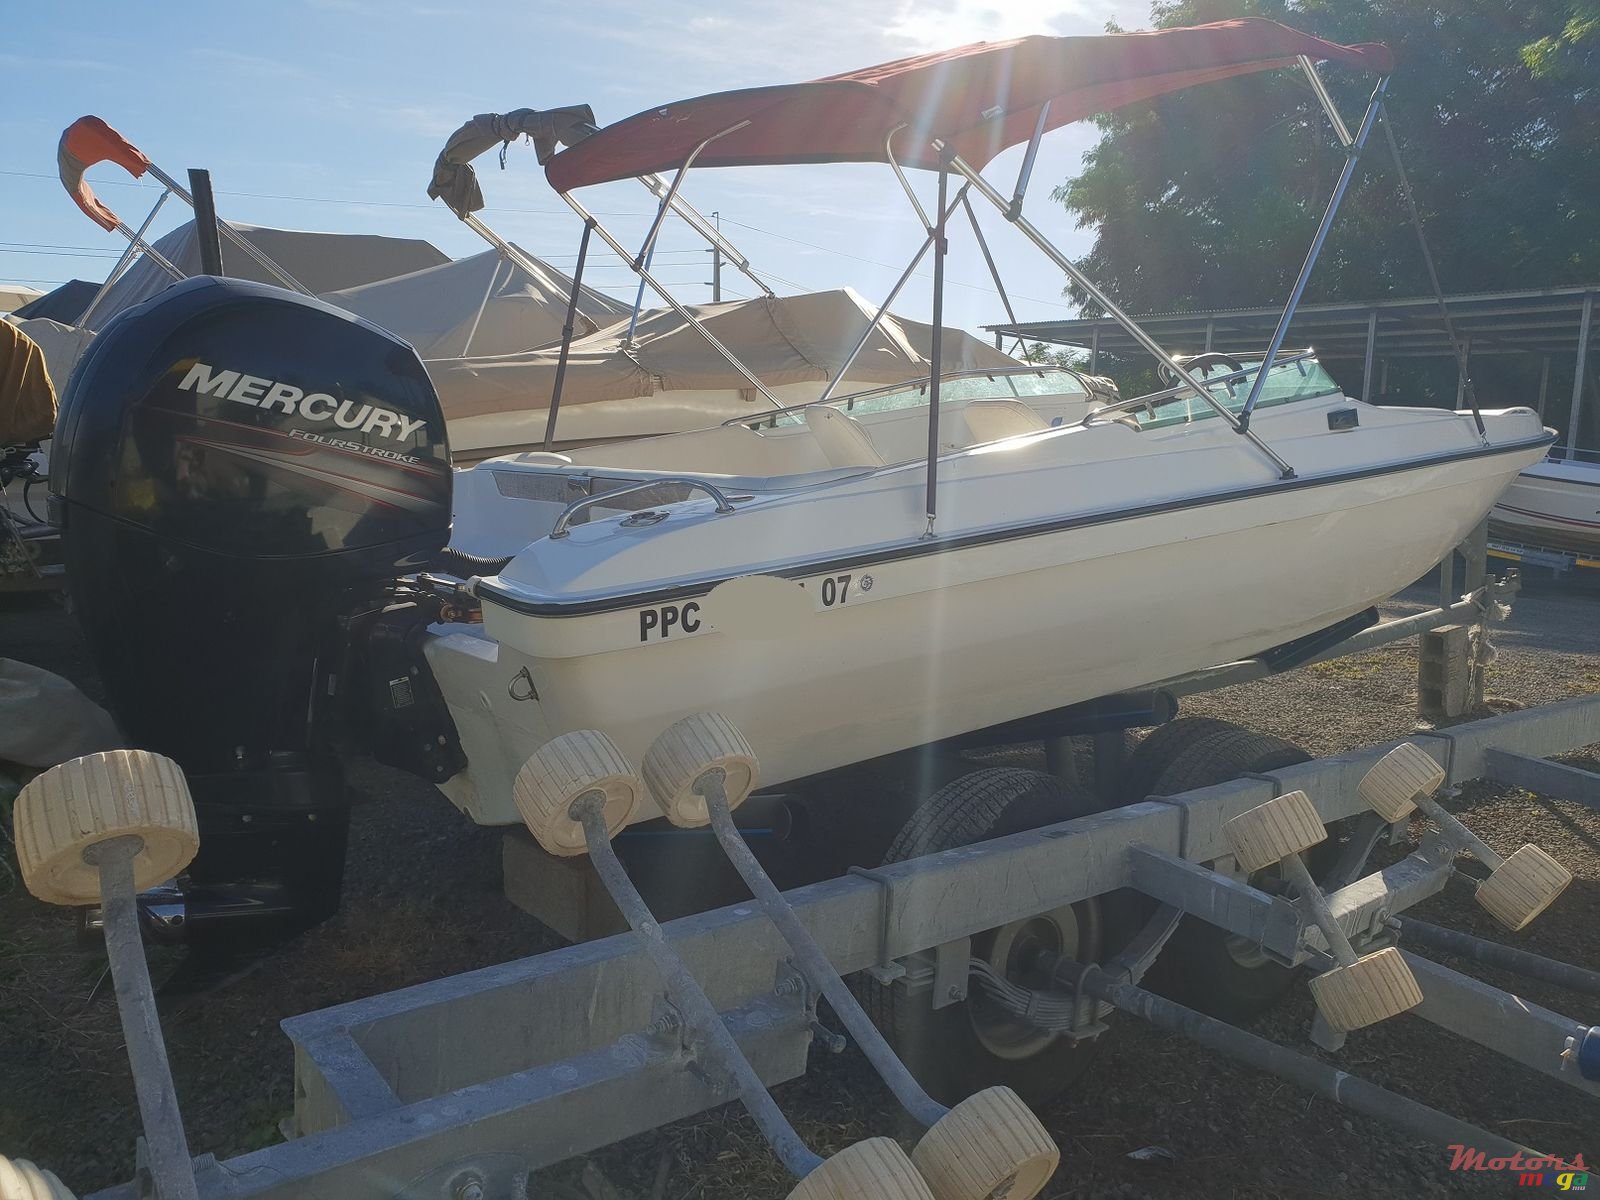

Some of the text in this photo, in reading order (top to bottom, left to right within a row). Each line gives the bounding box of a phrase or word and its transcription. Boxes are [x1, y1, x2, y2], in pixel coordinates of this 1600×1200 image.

[178, 363, 427, 442] MERCURY
[288, 428, 421, 465] FOURSTROKE
[640, 574, 852, 642] PPC 07
